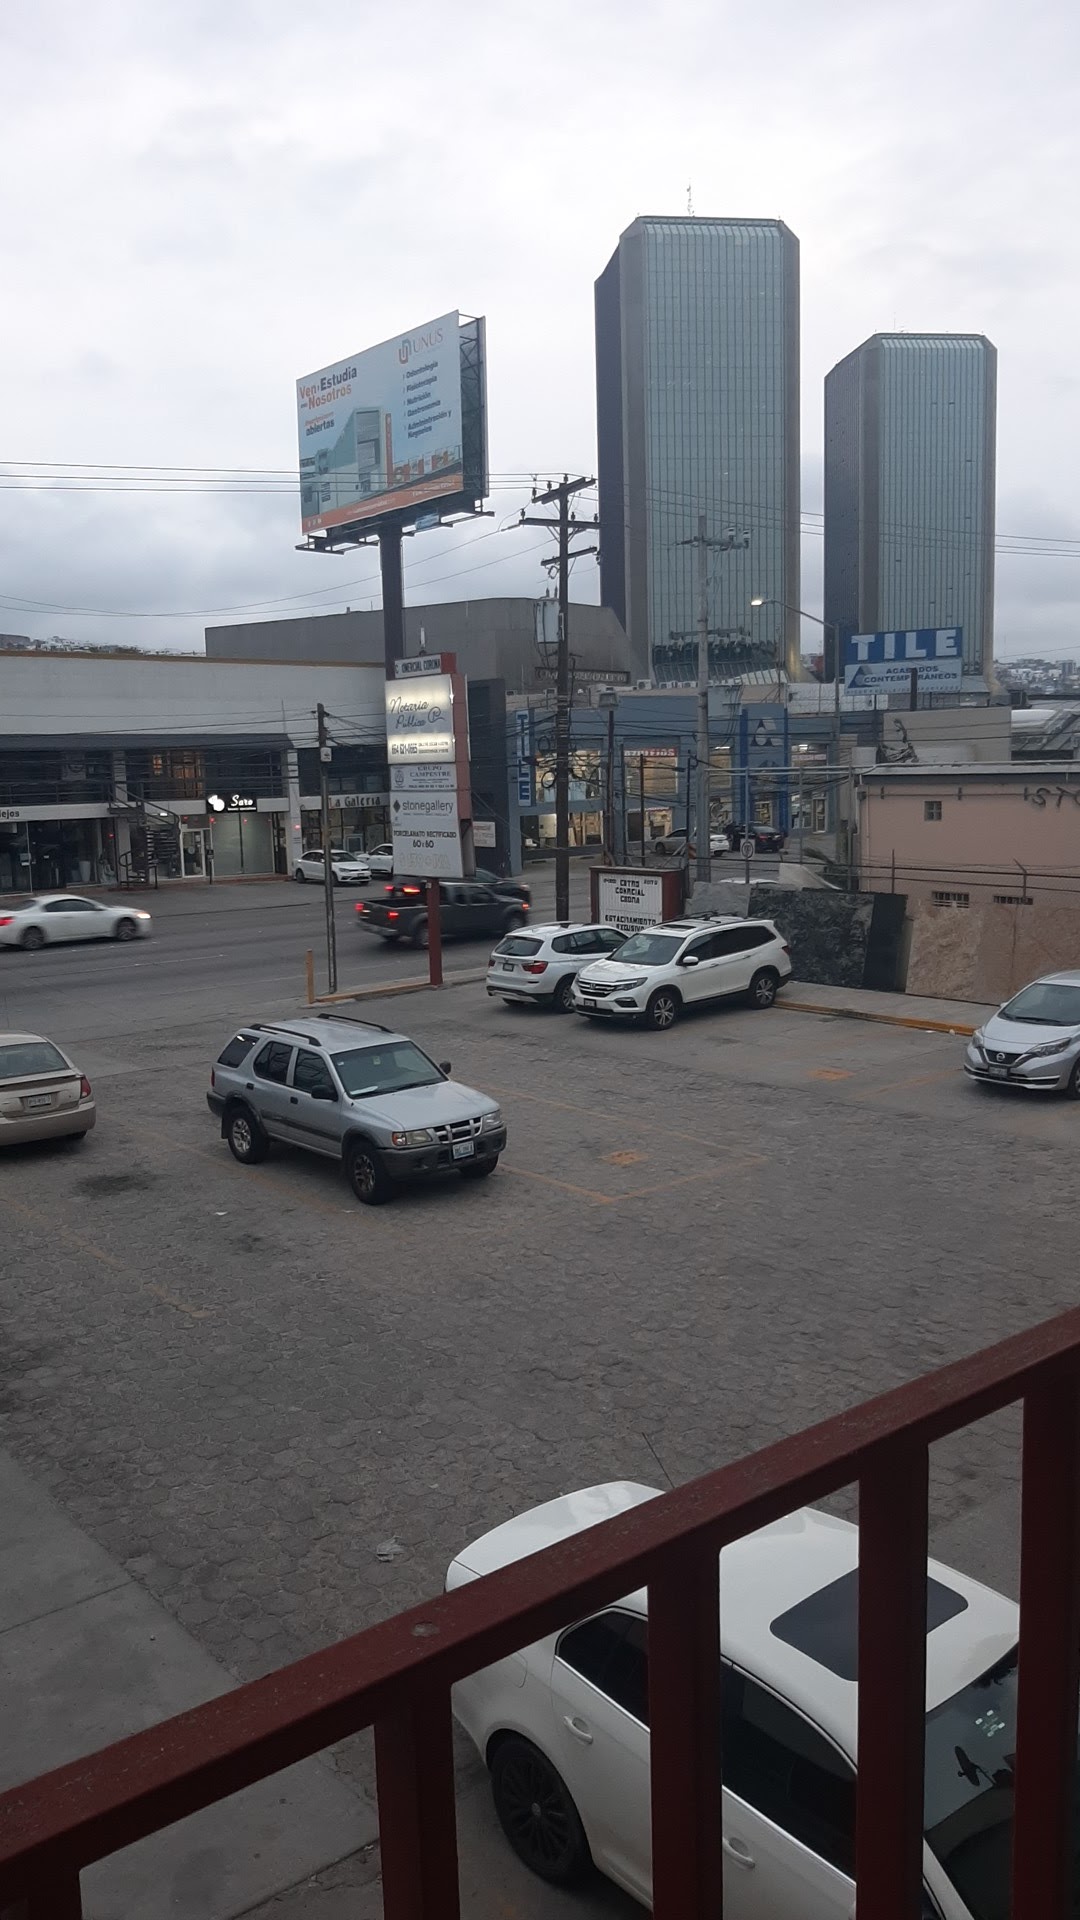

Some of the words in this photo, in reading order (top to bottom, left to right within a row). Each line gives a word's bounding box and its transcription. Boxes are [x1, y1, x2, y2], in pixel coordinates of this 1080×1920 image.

[413, 328, 443, 353] UNUS
[320, 366, 357, 391] Estudia
[308, 384, 352, 410] Nosotros
[306, 419, 335, 436] abiertas
[851, 629, 957, 660] TILE
[517, 714, 530, 801] TILE
[402, 800, 453, 814] stonegallery
[393, 830, 425, 838] PORCELANATO
